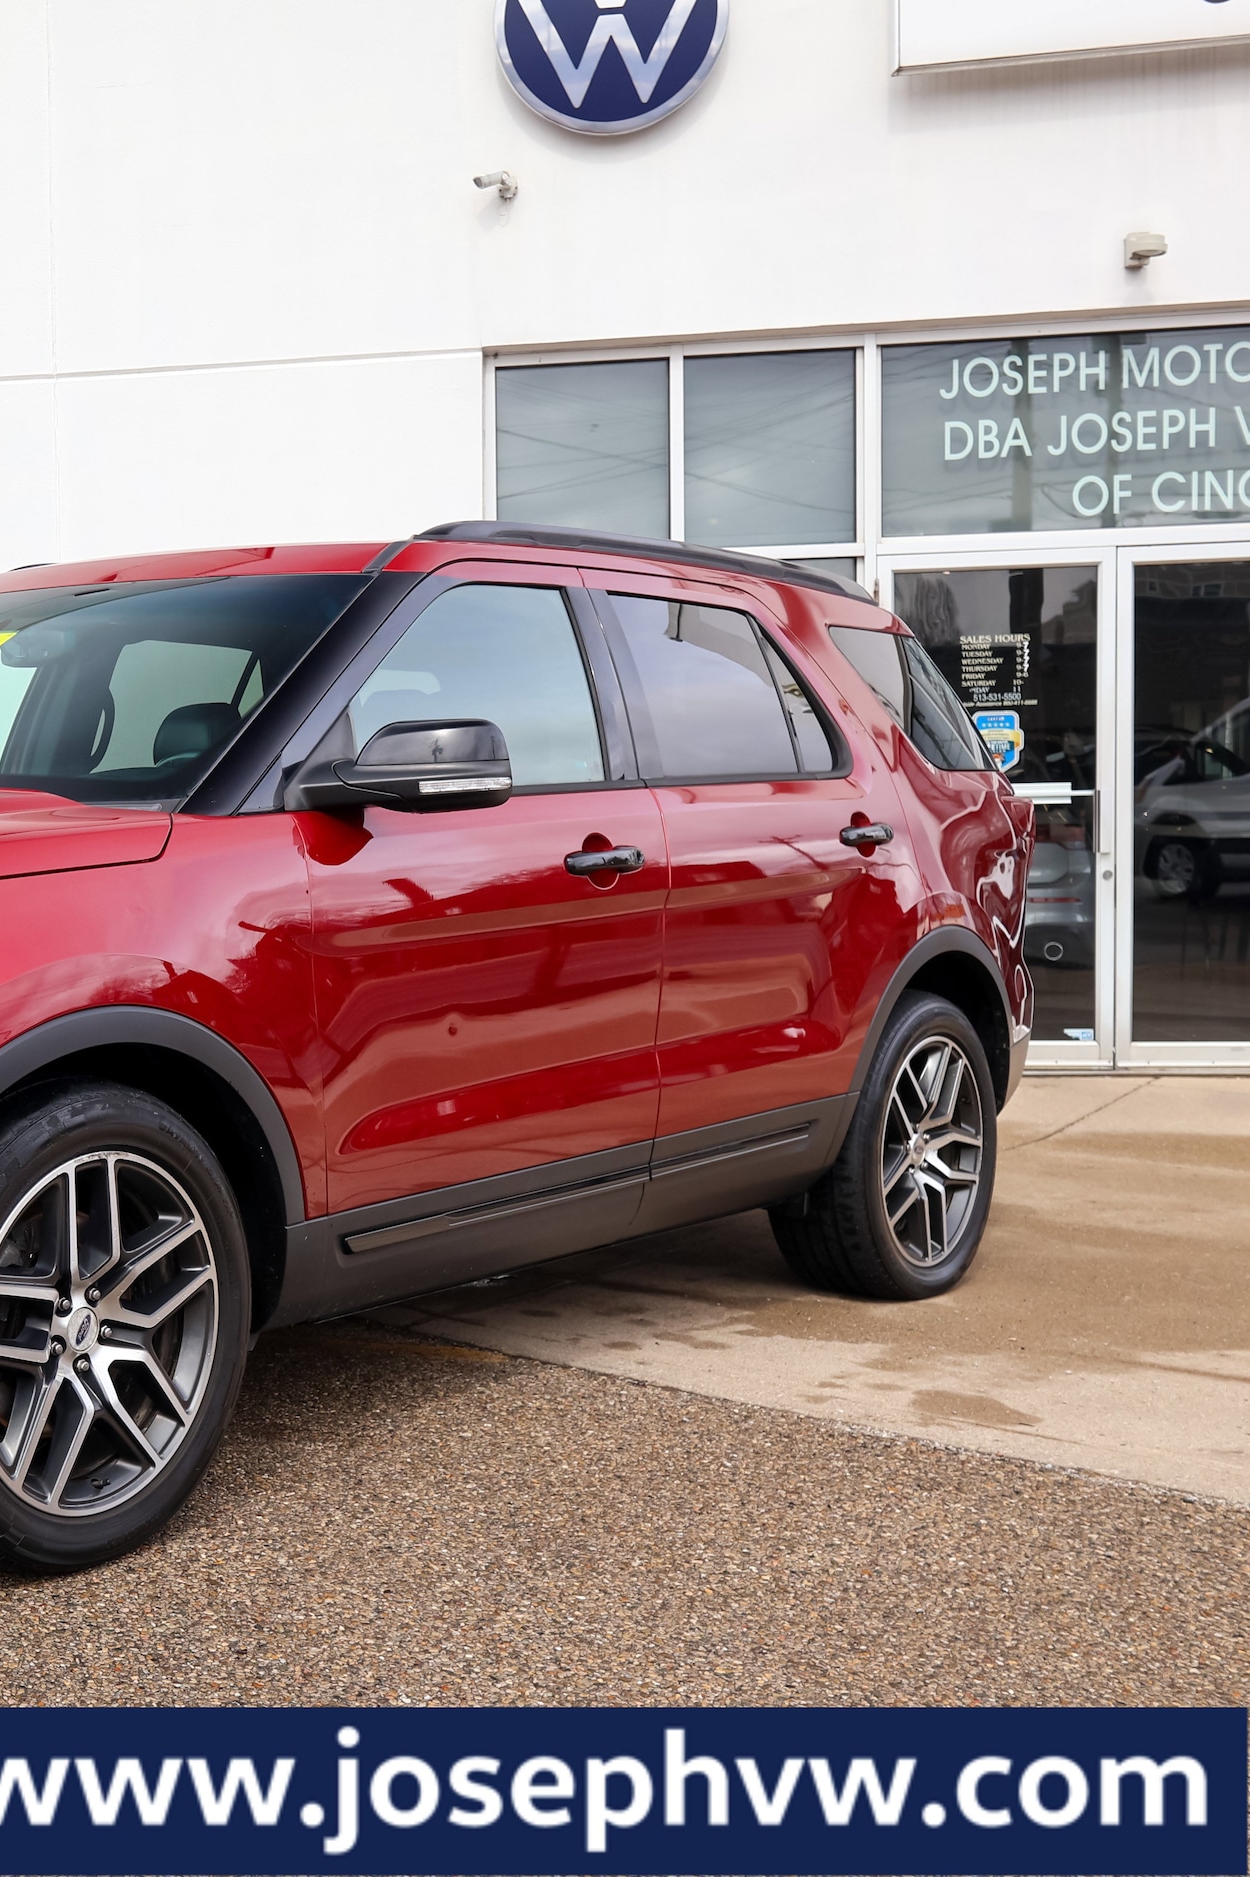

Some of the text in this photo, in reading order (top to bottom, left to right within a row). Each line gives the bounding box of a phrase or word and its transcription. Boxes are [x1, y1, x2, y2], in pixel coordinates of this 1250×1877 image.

[939, 350, 1106, 400] JOSEPH
[944, 417, 1033, 461] DBA
[1047, 406, 1216, 456] JOSEPH
[1072, 474, 1132, 517] OF
[959, 633, 1031, 645] SALES HOURS
[961, 658, 1004, 666] WEDNESDAY
[961, 680, 997, 688] SATURDAY
[973, 692, 1021, 702] 513-531-5500
